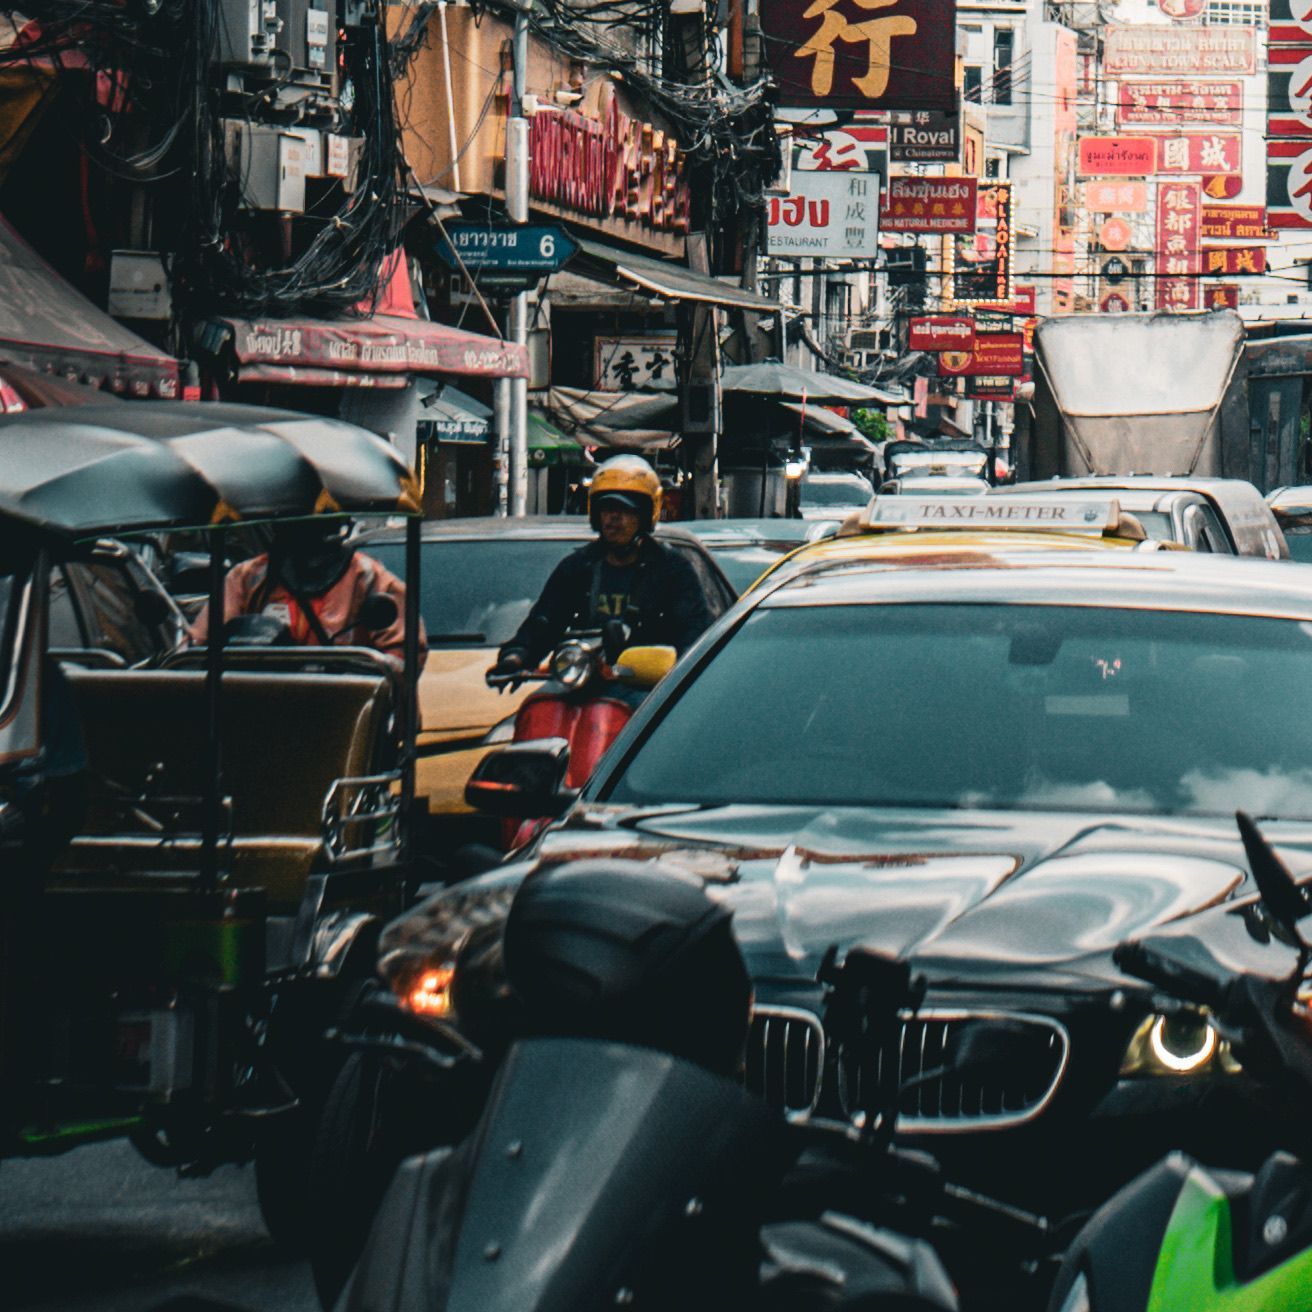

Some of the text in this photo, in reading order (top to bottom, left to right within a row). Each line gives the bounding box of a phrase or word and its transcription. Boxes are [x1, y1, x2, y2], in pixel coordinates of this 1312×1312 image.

[1159, 55, 1201, 68] TOWN
[1204, 55, 1248, 68] SCALA
[903, 127, 955, 147] Royal
[905, 148, 955, 158] Chinatown
[453, 231, 556, 258] เยาวราช 6
[921, 503, 1066, 522] TAXI-METER
